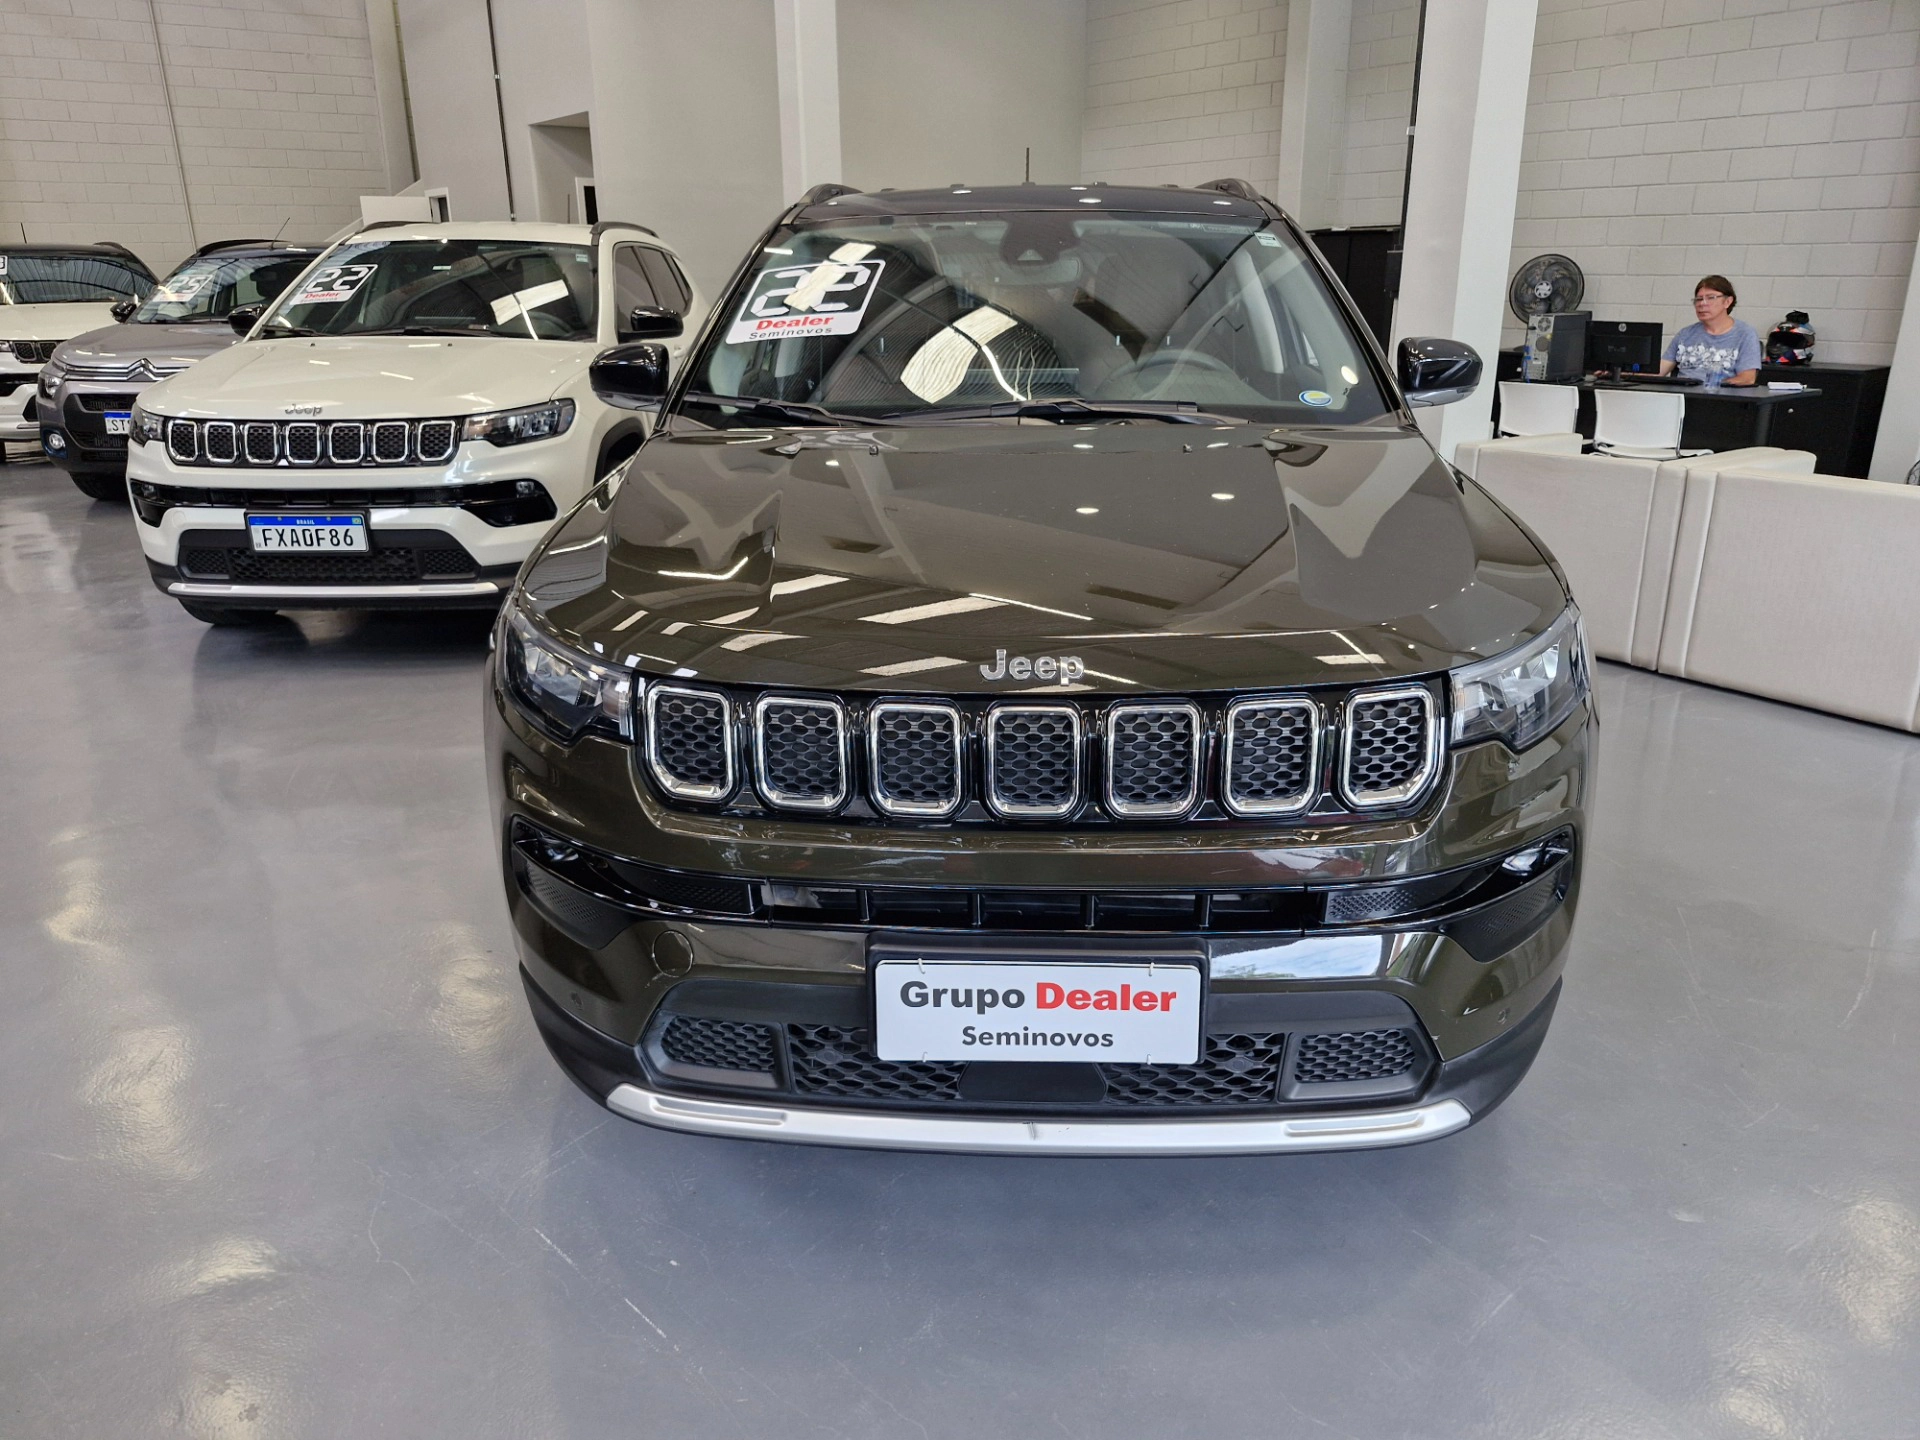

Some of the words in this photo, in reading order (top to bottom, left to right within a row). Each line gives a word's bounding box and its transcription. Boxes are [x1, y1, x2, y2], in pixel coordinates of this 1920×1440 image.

[305, 267, 370, 292] 22
[750, 264, 872, 318] 22
[749, 327, 832, 340] Seminovos
[756, 316, 834, 331] Dealer
[285, 403, 322, 417] Jeep
[111, 419, 130, 431] ST
[980, 648, 1084, 686] Jeep
[900, 981, 1025, 1015] Grupo
[1036, 982, 1177, 1012] Dealer
[961, 1026, 1114, 1047] Seminovos
